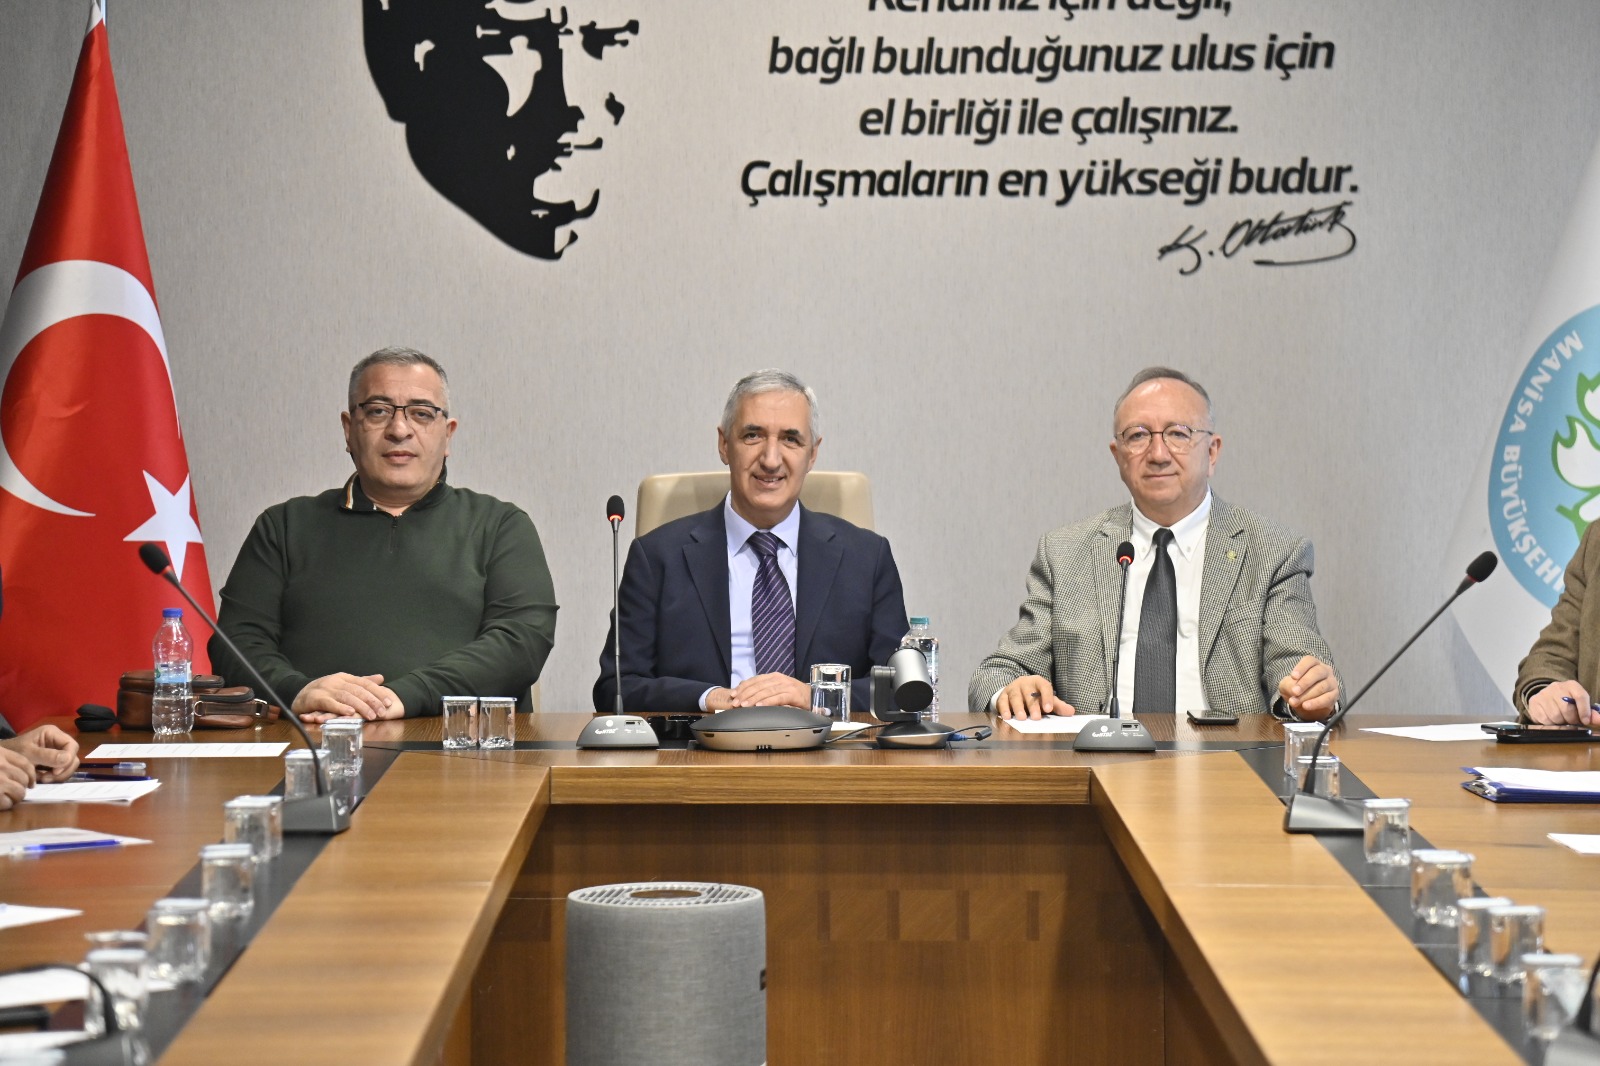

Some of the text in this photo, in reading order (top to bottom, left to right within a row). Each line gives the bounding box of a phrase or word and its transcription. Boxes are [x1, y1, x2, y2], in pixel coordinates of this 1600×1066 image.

[768, 31, 1336, 85] bağlı bulunduğunuz ulus için
[859, 96, 1240, 146] el birliği ile çalışınız.
[740, 156, 1360, 207] Çalışmaların en yükseği budur.
[1509, 329, 1584, 434] MANİSA
